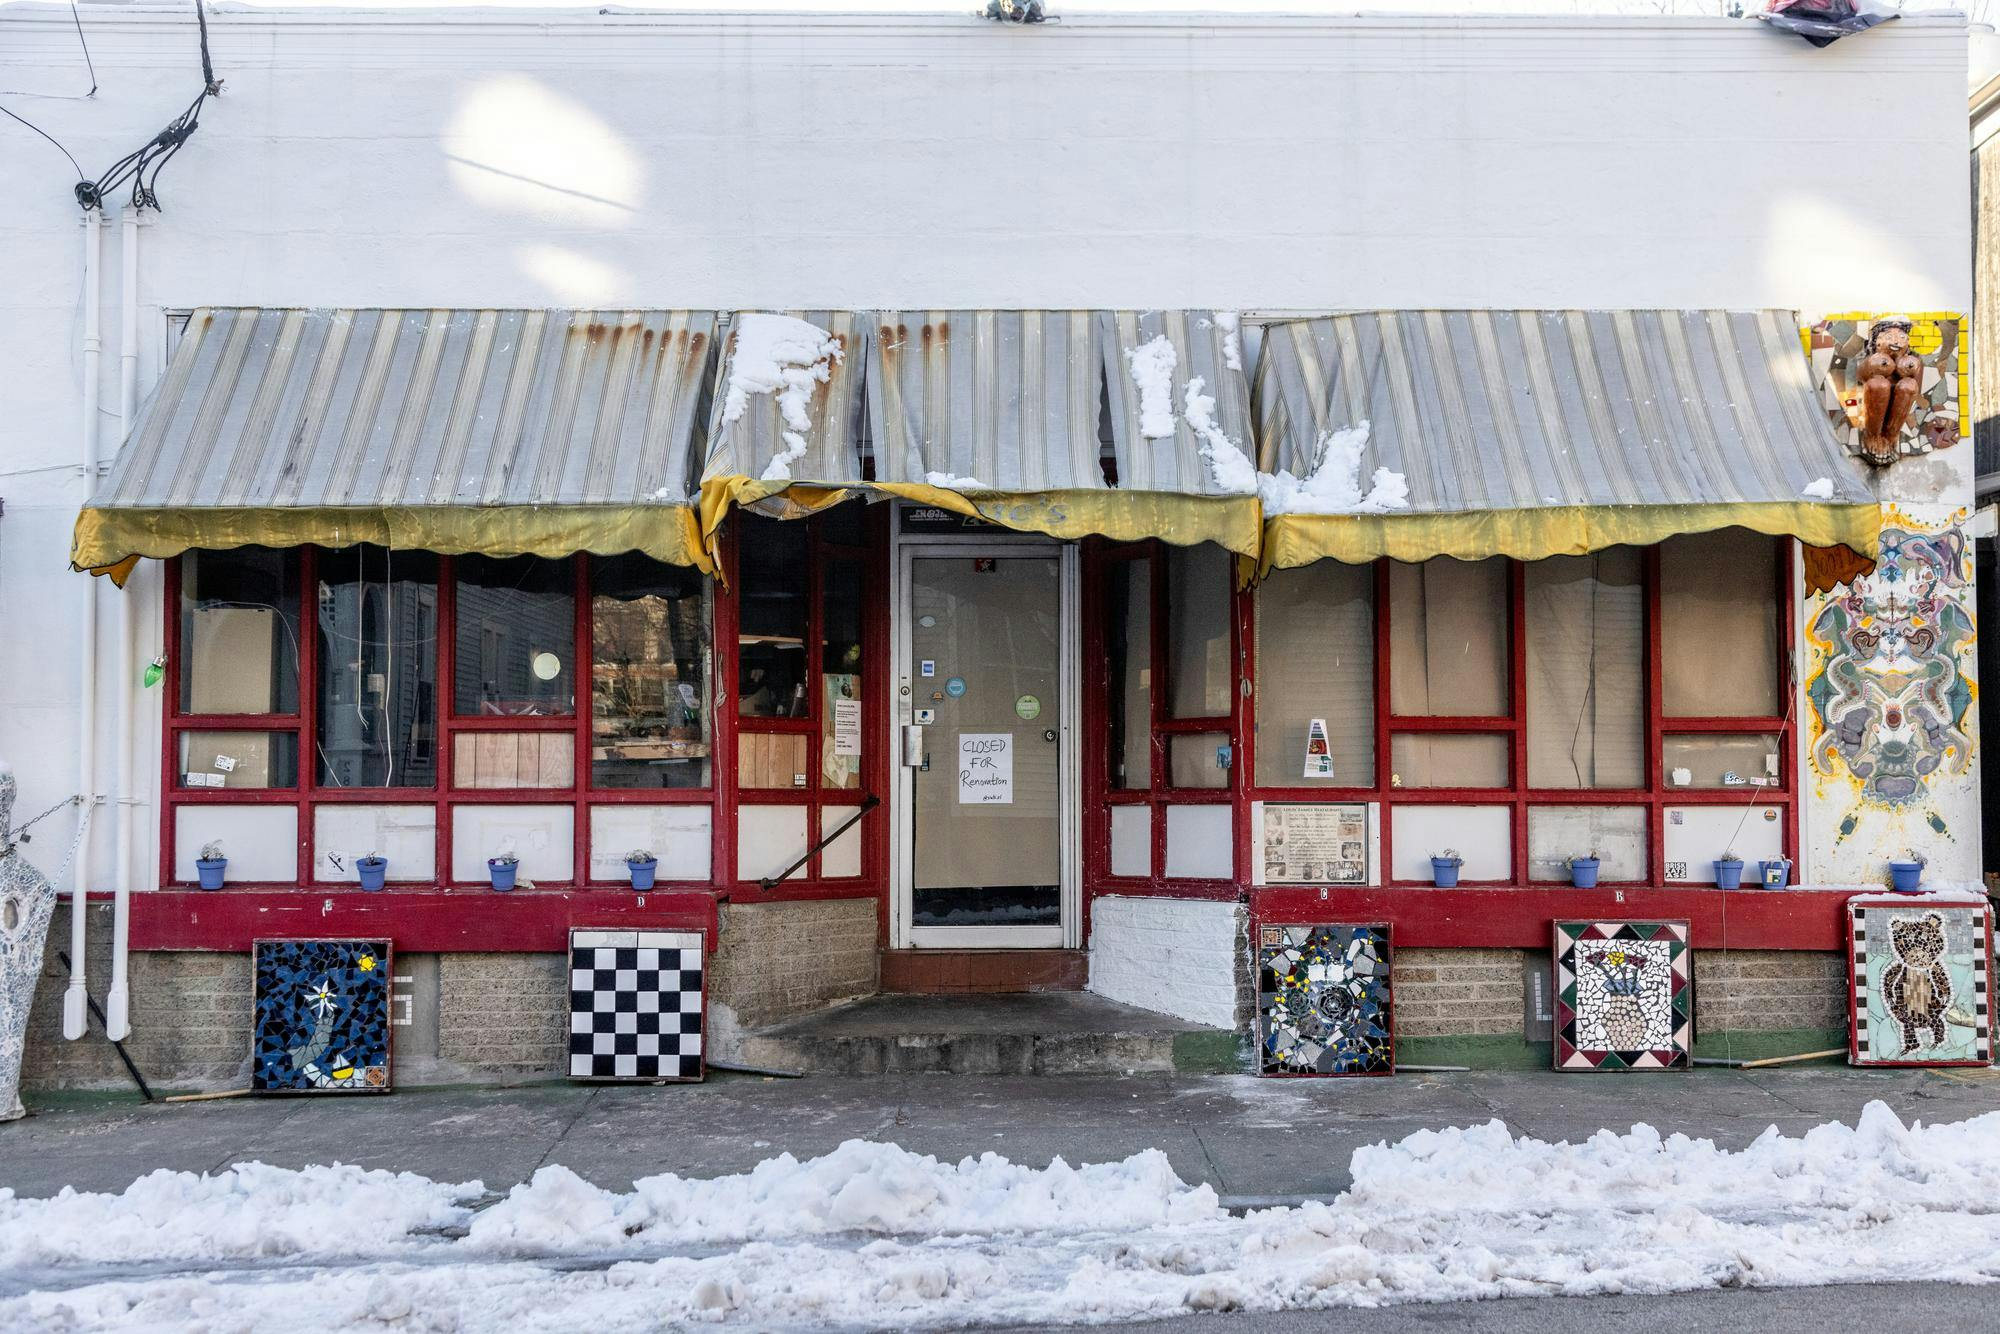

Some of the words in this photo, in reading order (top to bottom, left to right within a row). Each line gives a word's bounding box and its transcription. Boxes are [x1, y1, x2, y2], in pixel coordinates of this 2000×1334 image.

[962, 739, 1006, 753] CLOSED
[969, 756, 998, 769] FOR
[960, 770, 1008, 788] Renovation
